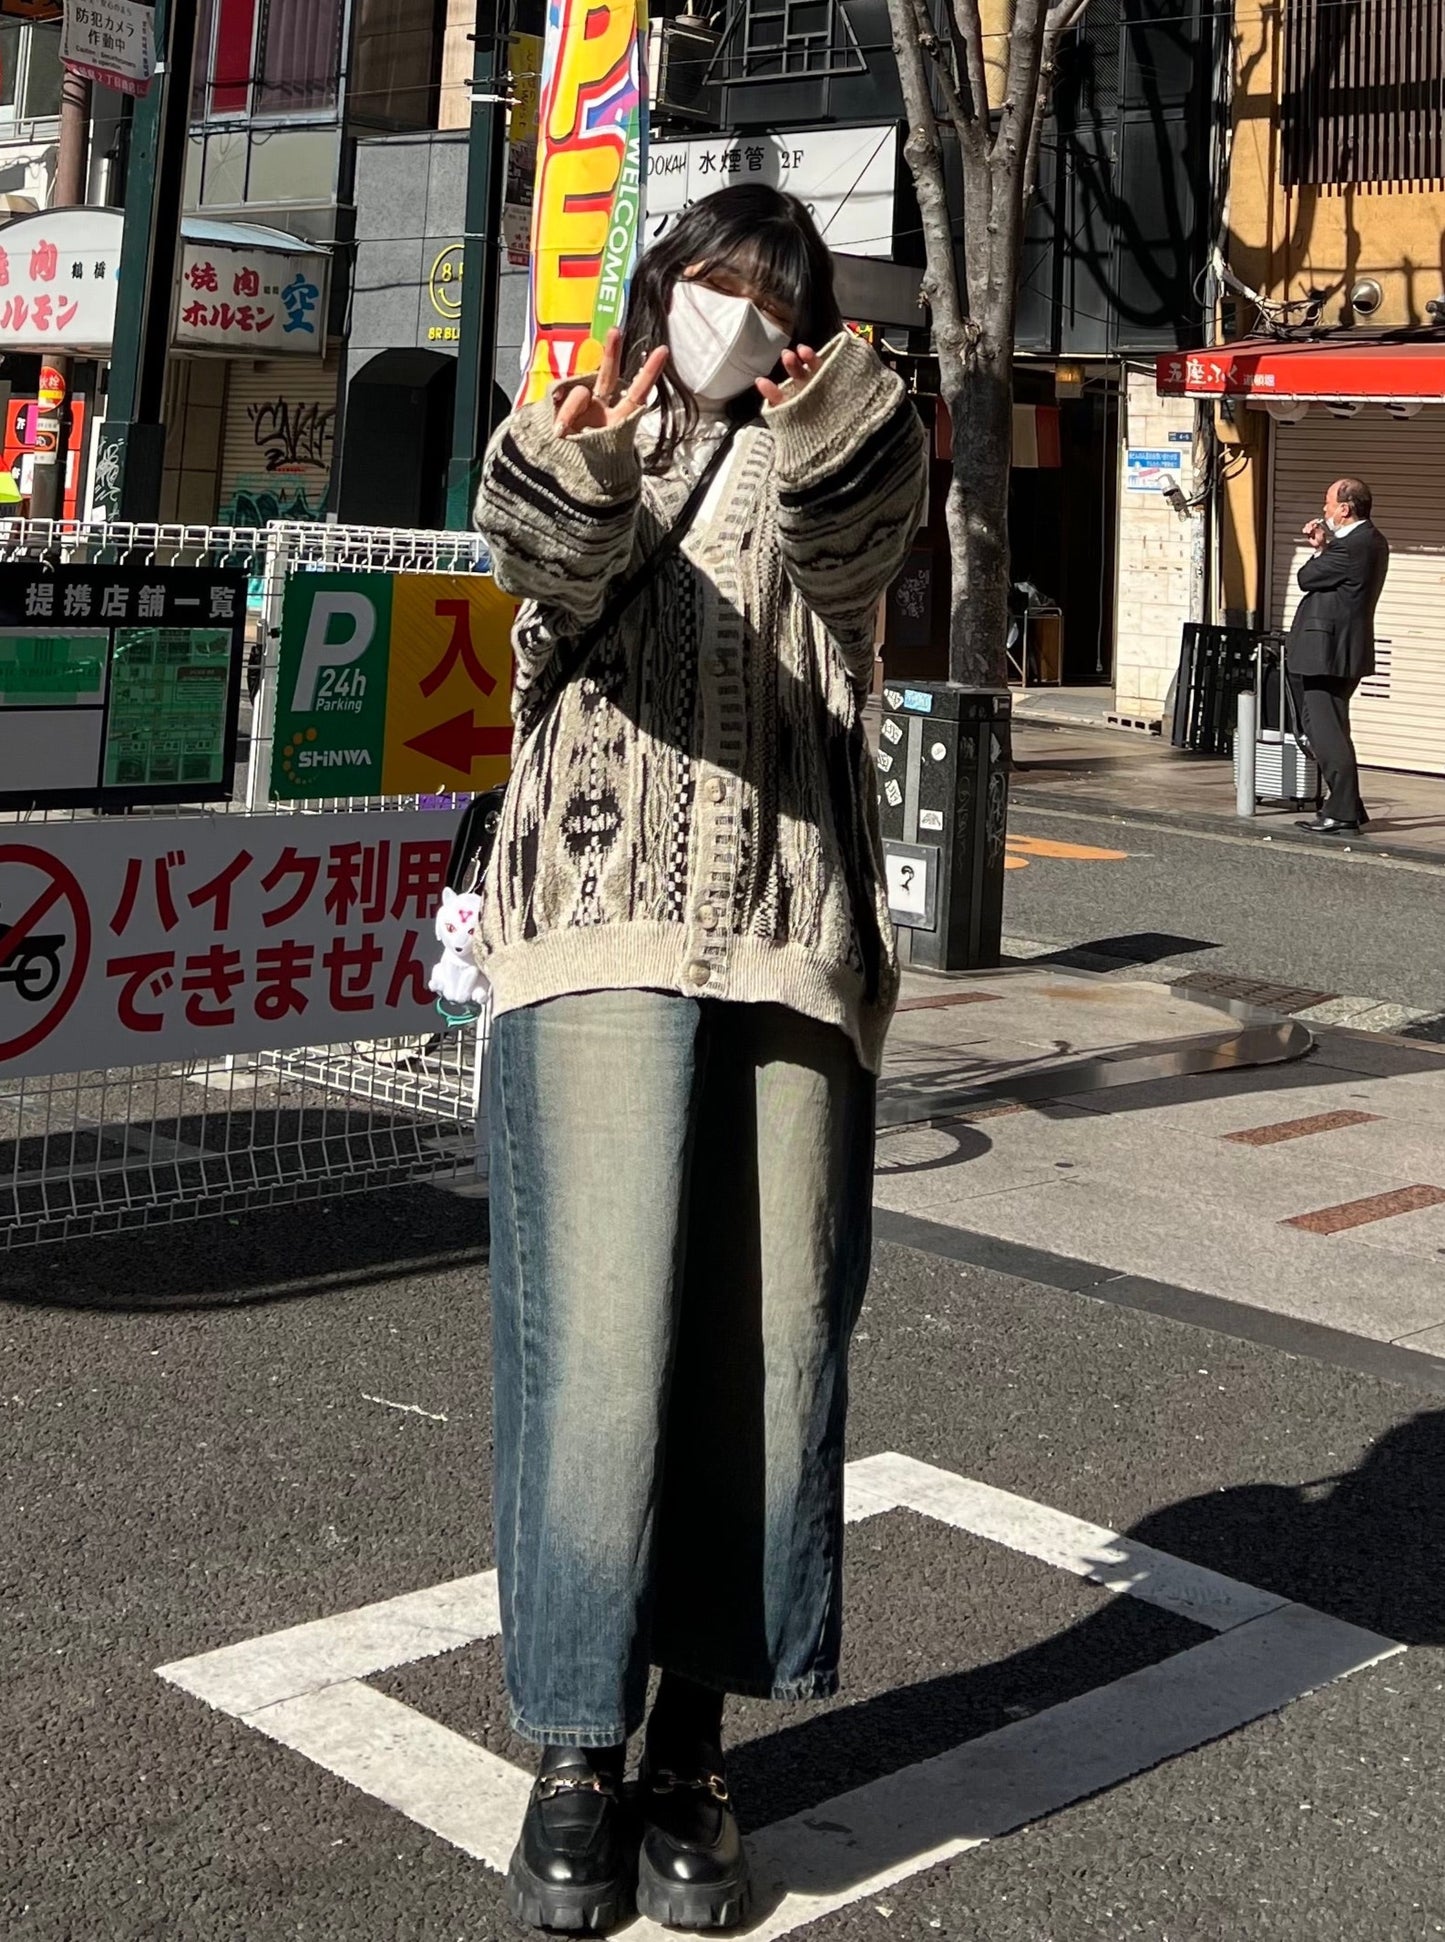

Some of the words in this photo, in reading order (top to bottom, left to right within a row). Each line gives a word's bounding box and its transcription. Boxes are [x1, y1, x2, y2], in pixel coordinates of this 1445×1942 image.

[76, 7, 134, 38] 防犯カメラ
[88, 29, 126, 53] 作動中
[699, 146, 765, 174] 水煙管
[781, 149, 804, 169] 2F
[597, 137, 640, 313] WELCOME!
[184, 262, 260, 297] 焼肉
[182, 300, 275, 333] ホルモン
[281, 273, 319, 333] 空
[25, 583, 236, 618] 提携店舗一覧
[291, 591, 377, 712] P
[318, 668, 367, 697] 24h
[315, 698, 363, 713] Parking
[110, 839, 453, 937] バイク利用
[106, 930, 437, 1032] できません
